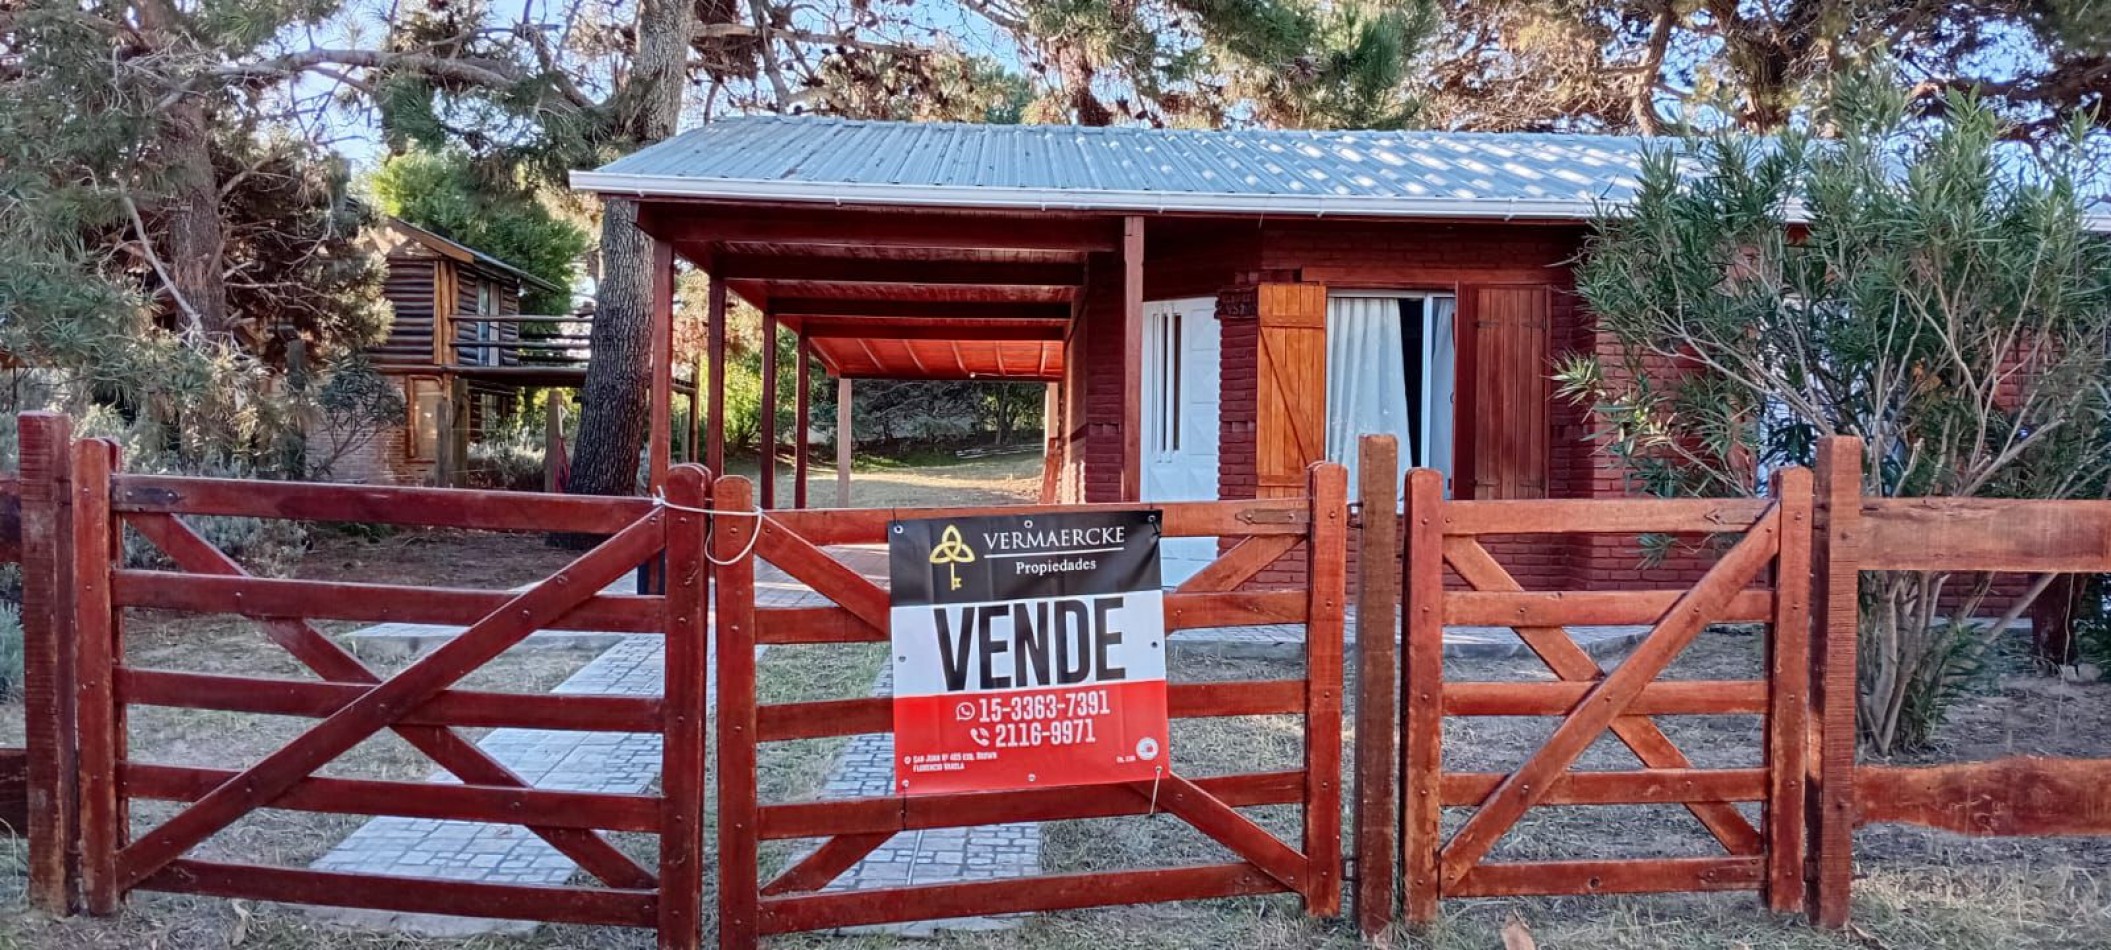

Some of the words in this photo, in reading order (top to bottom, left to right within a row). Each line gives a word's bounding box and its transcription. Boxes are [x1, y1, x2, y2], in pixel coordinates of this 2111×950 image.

[983, 526, 1126, 550] VERMAERCKE
[1015, 558, 1097, 575] Propiedades
[933, 597, 1127, 691] VENDE
[979, 690, 1111, 722] 15-3363-7391
[995, 718, 1096, 748] 2116-9971
